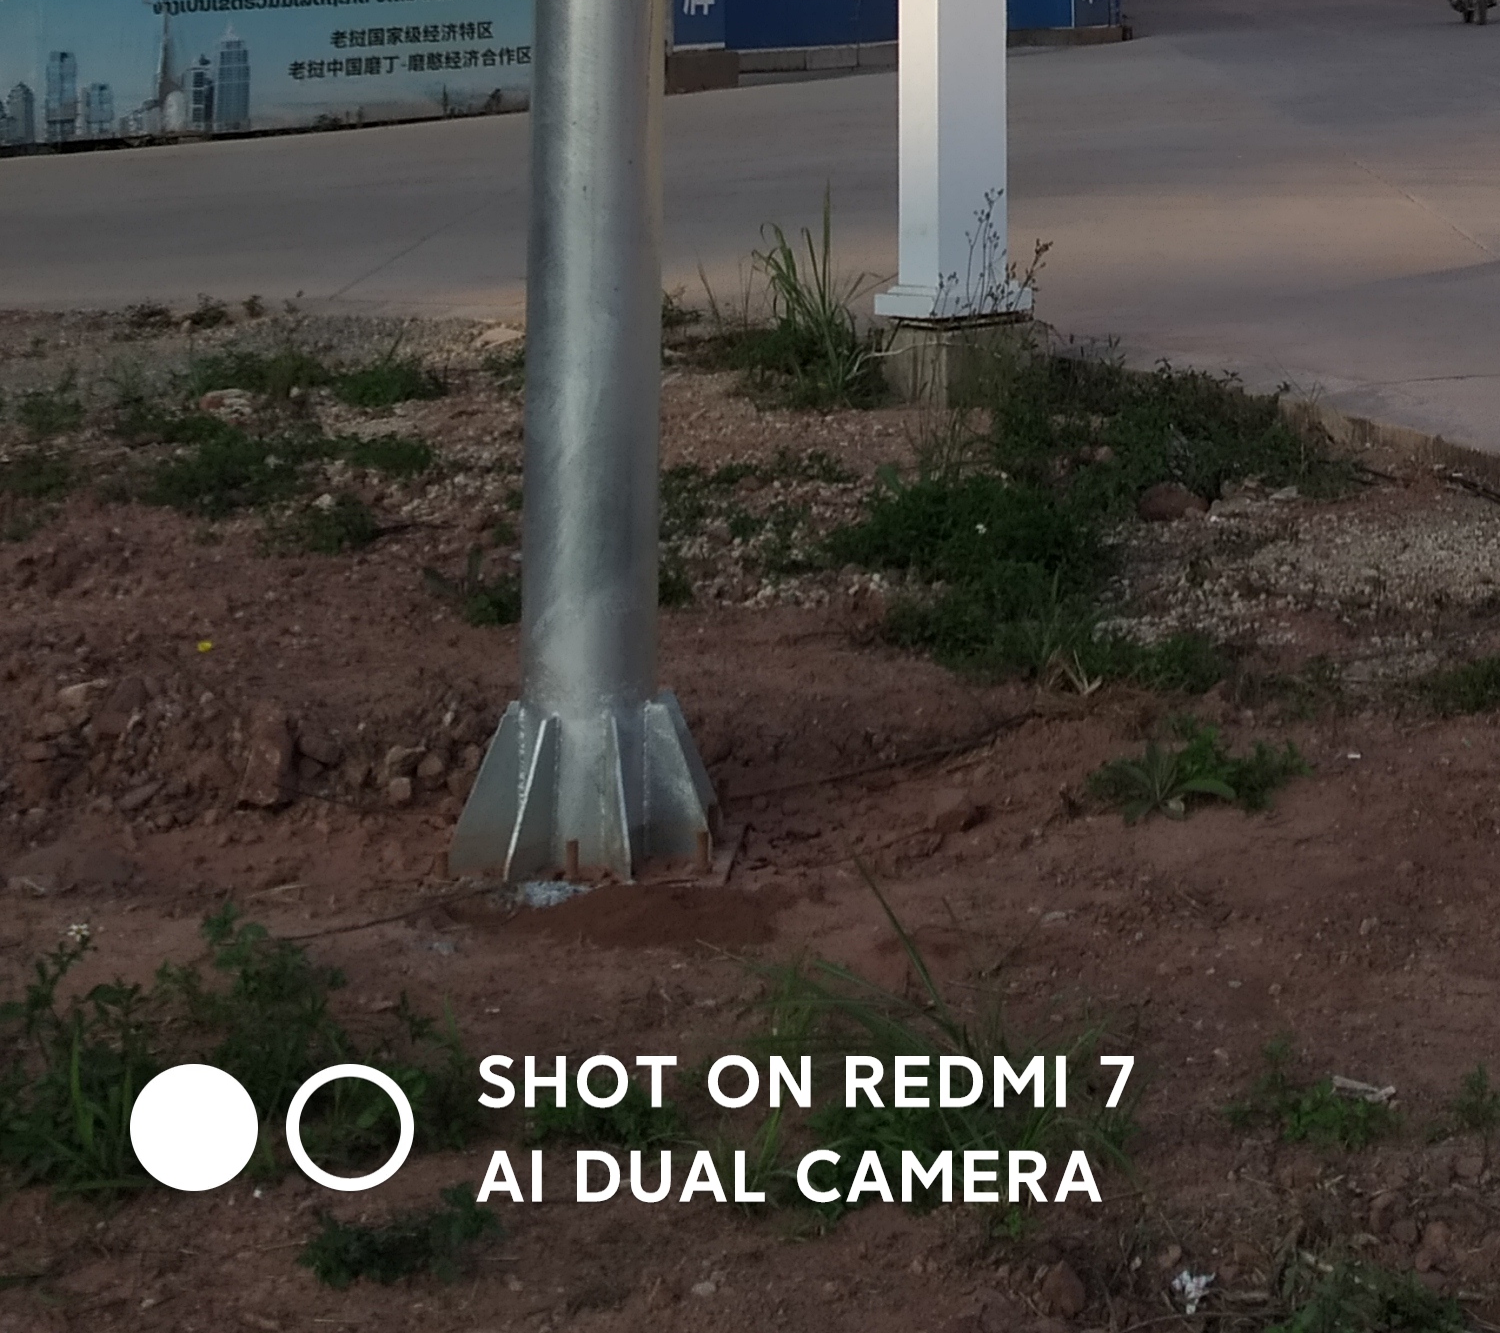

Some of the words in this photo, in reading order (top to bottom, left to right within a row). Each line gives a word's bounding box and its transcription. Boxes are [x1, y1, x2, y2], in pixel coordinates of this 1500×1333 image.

[330, 21, 494, 49] 老挝国家级经济特区
